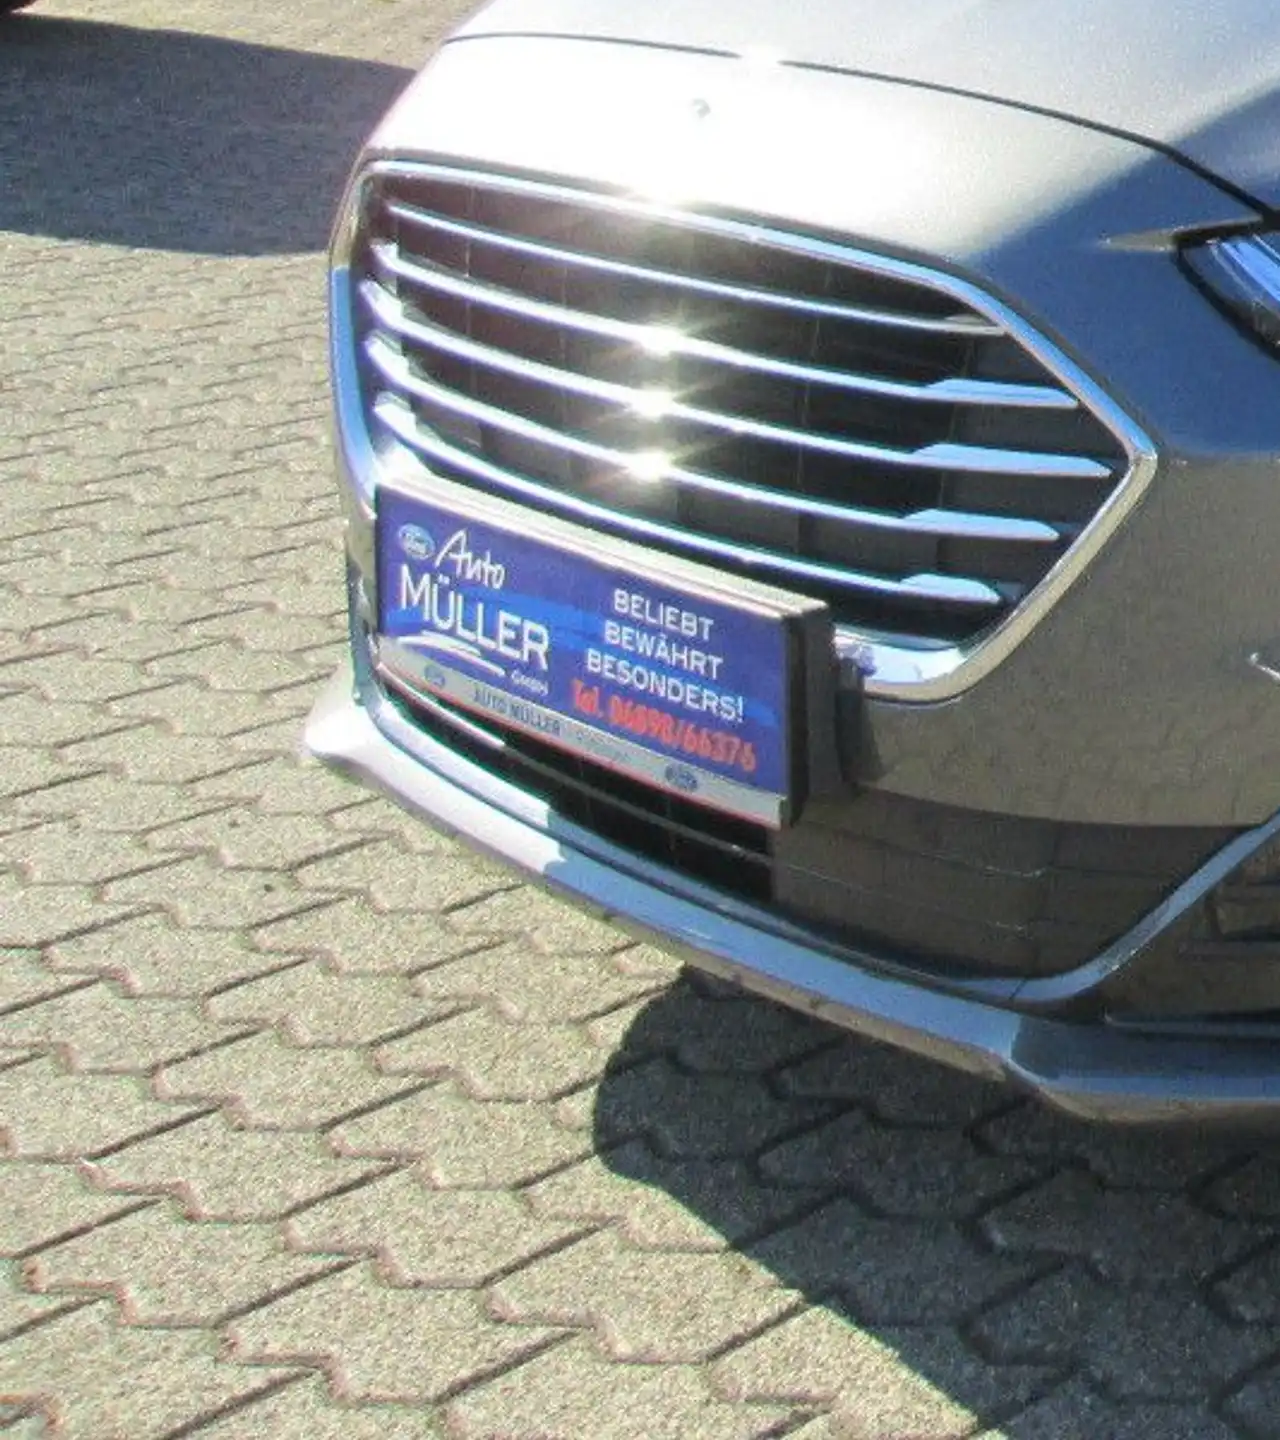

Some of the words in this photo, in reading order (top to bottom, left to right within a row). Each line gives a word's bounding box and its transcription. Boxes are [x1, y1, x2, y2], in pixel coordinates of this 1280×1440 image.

[434, 527, 506, 590] Auto
[401, 563, 549, 670] MÜLLER
[614, 588, 714, 641] BELIEBT
[604, 620, 723, 680] BEWÄHRT
[586, 648, 744, 724] BESONDERS!
